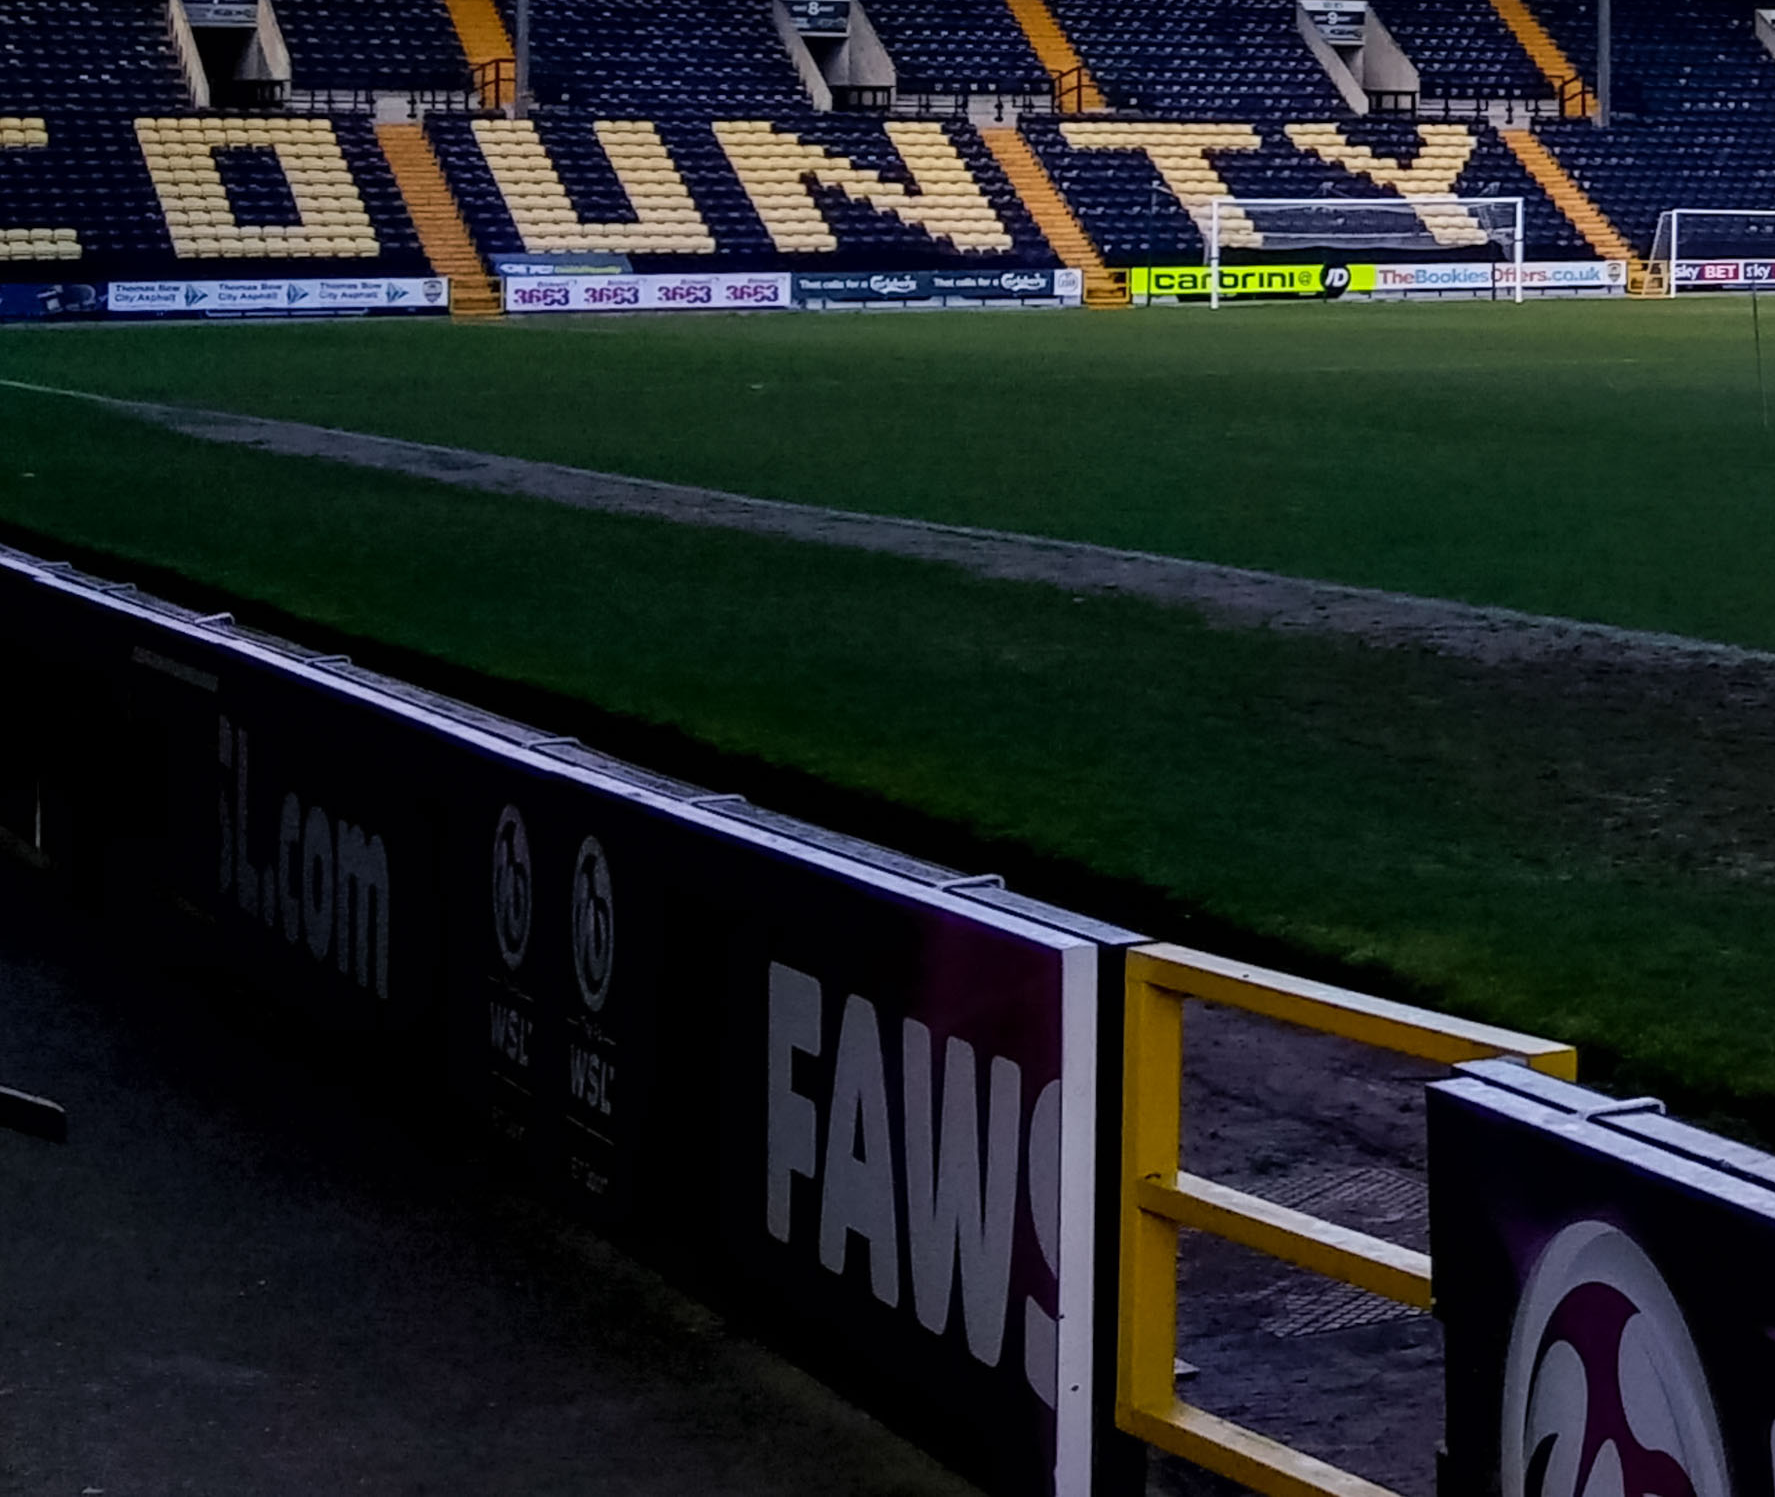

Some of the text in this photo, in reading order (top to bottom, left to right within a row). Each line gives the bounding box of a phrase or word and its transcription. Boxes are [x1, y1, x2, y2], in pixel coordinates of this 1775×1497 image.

[807, 1, 820, 17] 8
[1327, 11, 1339, 25] 9
[1154, 270, 1294, 290] carbrini
[1325, 268, 1349, 288] JD
[1675, 262, 1737, 281] sky BET
[1745, 262, 1771, 280] sky
[115, 284, 156, 293] Thomas
[218, 283, 256, 292] Thomas
[319, 282, 357, 291] Thomas
[726, 283, 779, 304] 3663
[115, 292, 176, 304] City Asphalt
[217, 291, 278, 303] City Asphalt
[318, 290, 378, 302] City Asphalt
[513, 286, 570, 307] 3663
[583, 285, 640, 306] 3663
[657, 285, 712, 305] 3663
